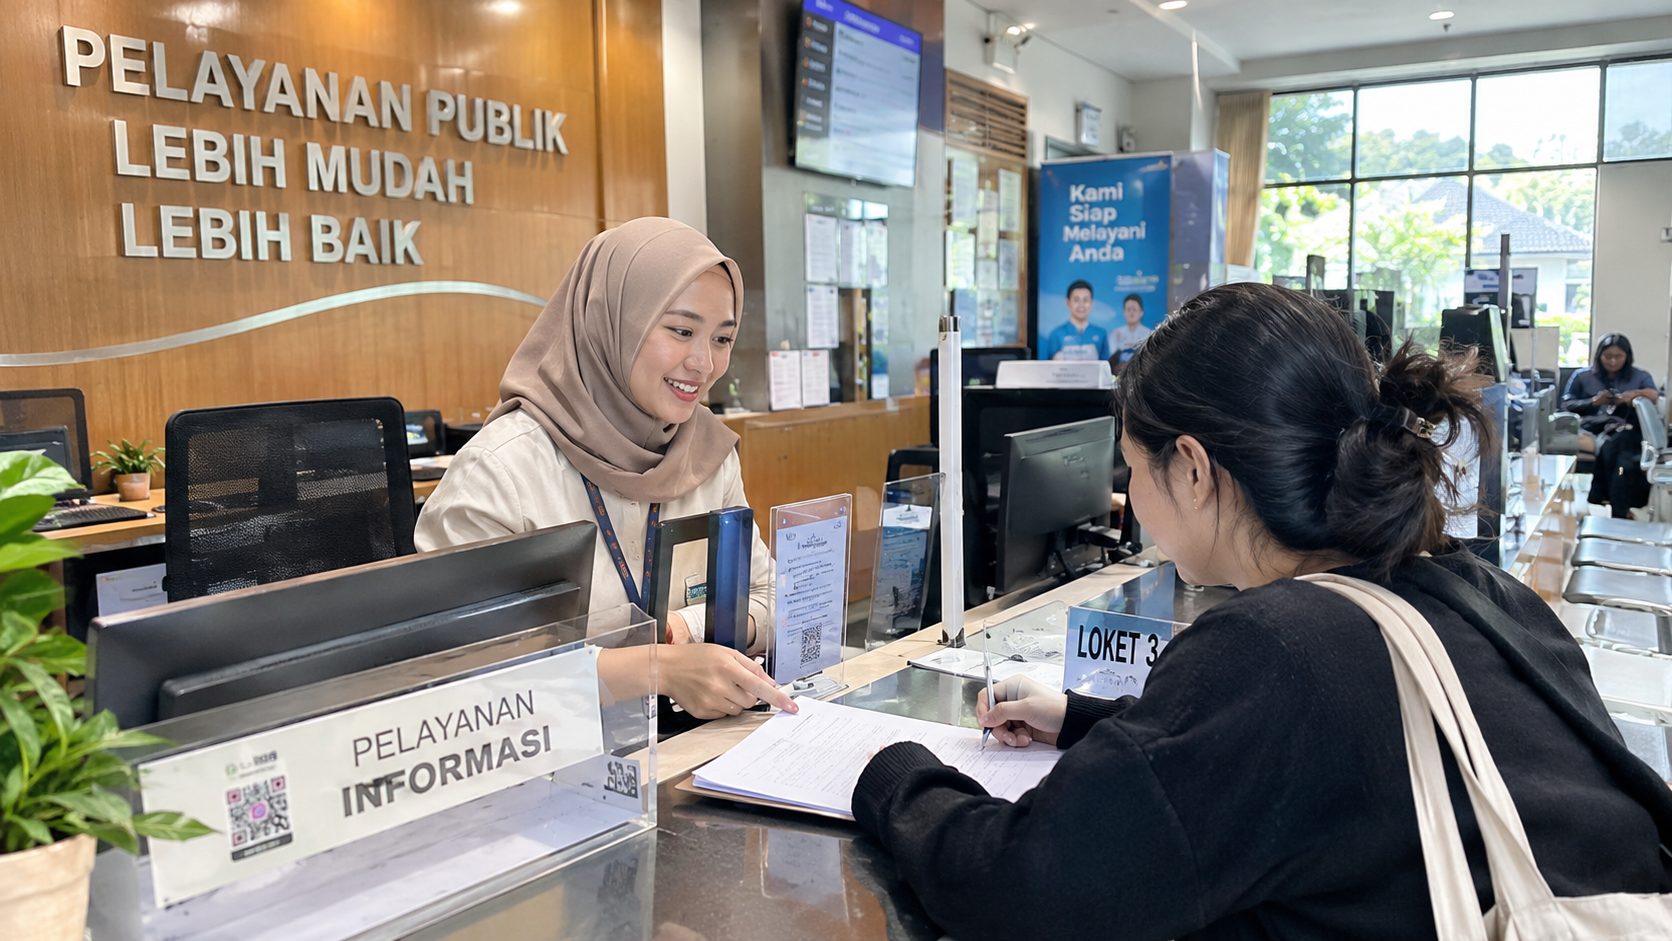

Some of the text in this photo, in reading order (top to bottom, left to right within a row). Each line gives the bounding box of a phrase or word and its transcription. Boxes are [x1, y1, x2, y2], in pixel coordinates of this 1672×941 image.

[61, 25, 569, 155] PELAYANAN PUBLIK
[112, 119, 474, 204] LEBIH MUDAH
[1069, 181, 1123, 202] Kami
[1069, 203, 1118, 225] Siap
[121, 202, 424, 265] LEBIH BAIK
[1063, 220, 1147, 244] Melayani
[1068, 243, 1125, 263] Anda
[1077, 625, 1140, 665] LOKET
[1146, 633, 1159, 667] 3
[353, 690, 535, 767] PELAYANAN
[341, 725, 552, 818] INFORMASI
